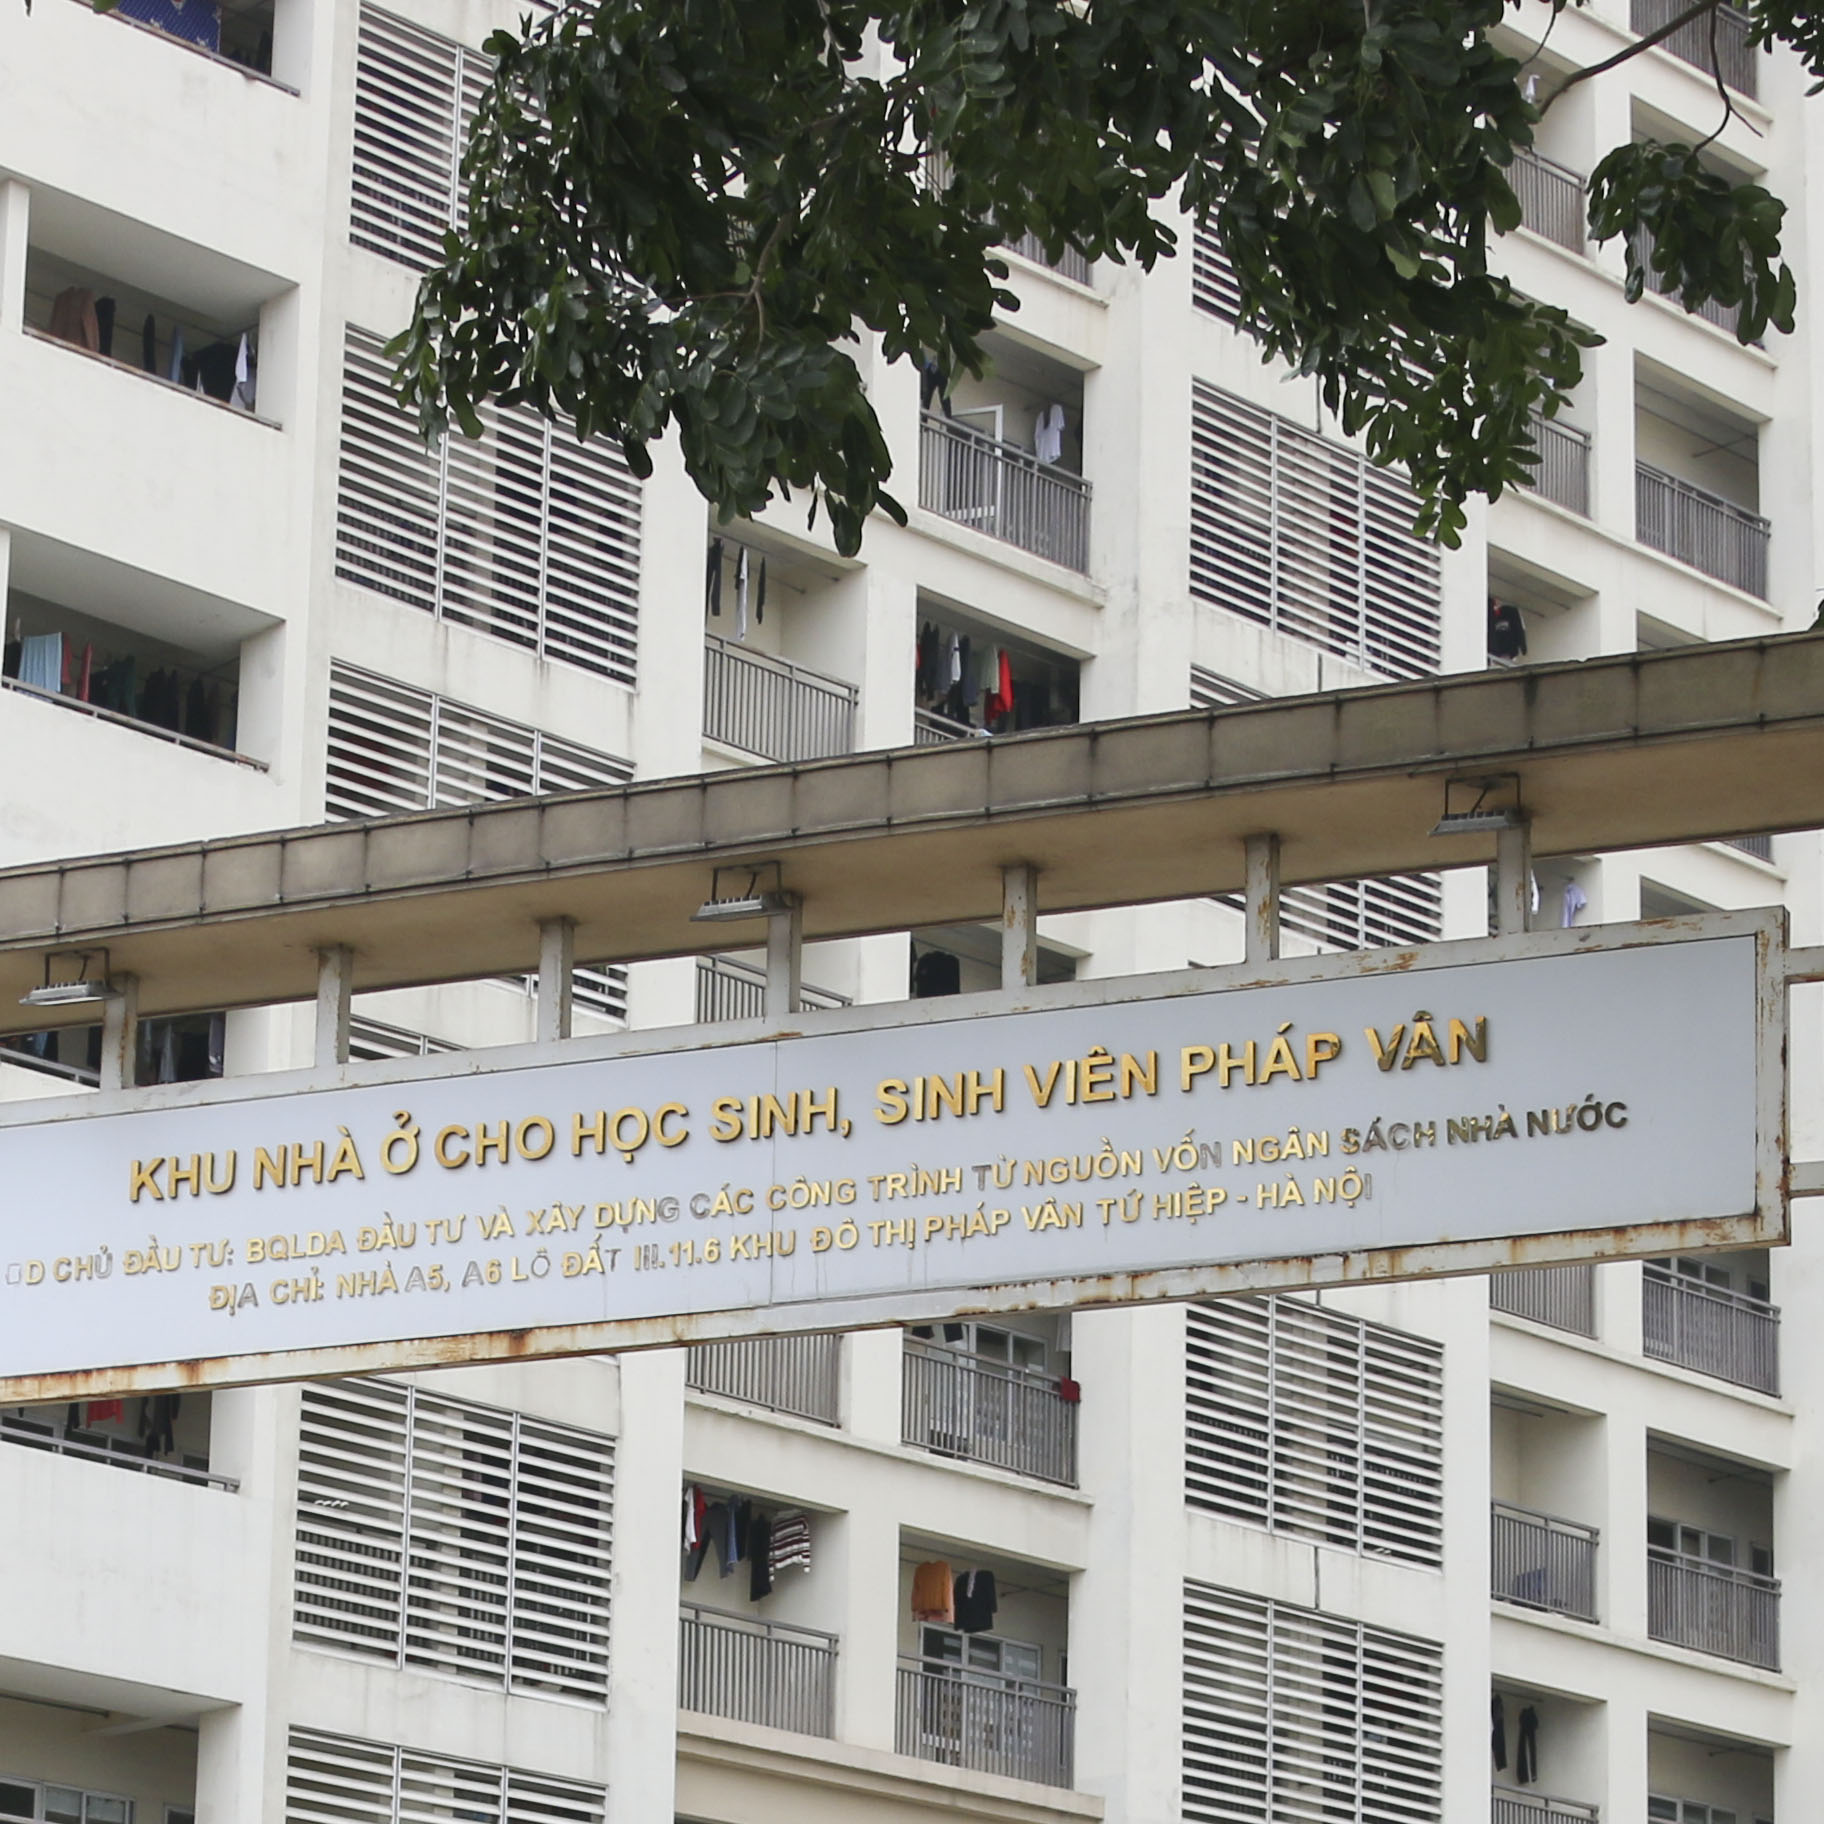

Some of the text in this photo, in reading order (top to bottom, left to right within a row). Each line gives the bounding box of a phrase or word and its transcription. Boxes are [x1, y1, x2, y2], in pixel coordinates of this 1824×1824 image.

[52, 1244, 114, 1284] CHỦ
[121, 1234, 182, 1275] ĐẦU
[244, 1229, 346, 1264] BQLDA
[356, 1212, 417, 1252] ĐẦU
[424, 1213, 466, 1245] TƯ
[477, 1205, 514, 1241] VÀ
[525, 1201, 586, 1236] XÂY
[593, 1196, 679, 1233] DỰNG
[689, 1181, 754, 1221] CÁC
[764, 1175, 856, 1211] CÔNG
[867, 1161, 963, 1200] TRÌNH
[971, 1154, 1016, 1191] TỪ
[1022, 1136, 1143, 1186] NGUỒN
[1152, 1128, 1222, 1173] VỐN
[1231, 1125, 1330, 1166] NGÂN
[1340, 1115, 1437, 1154] SÁCH
[1446, 1103, 1519, 1146] NHÀ
[1526, 1093, 1629, 1137] NƯỚC
[129, 1010, 1489, 1202] KHU NHÀ Ở CHO HỌC SINH, SINH VIÊN PHÁP VÂN
[208, 1283, 258, 1315] ĐỊA
[335, 1260, 399, 1298] NHÀ
[404, 1264, 451, 1293] A5,
[461, 1257, 503, 1289] A6
[511, 1247, 551, 1282] LÔ
[561, 1233, 623, 1278] ĐẤT
[729, 1230, 797, 1262] KHU
[810, 1217, 860, 1254] ĐÔ
[867, 1217, 916, 1250] THỊ
[923, 1201, 1011, 1243] PHÁP
[1020, 1197, 1084, 1232] VÂN
[1095, 1188, 1144, 1225] TỨ
[1151, 1181, 1228, 1226] HIỆP
[1256, 1172, 1306, 1210] HÀ
[1312, 1165, 1373, 1208] NỘI
